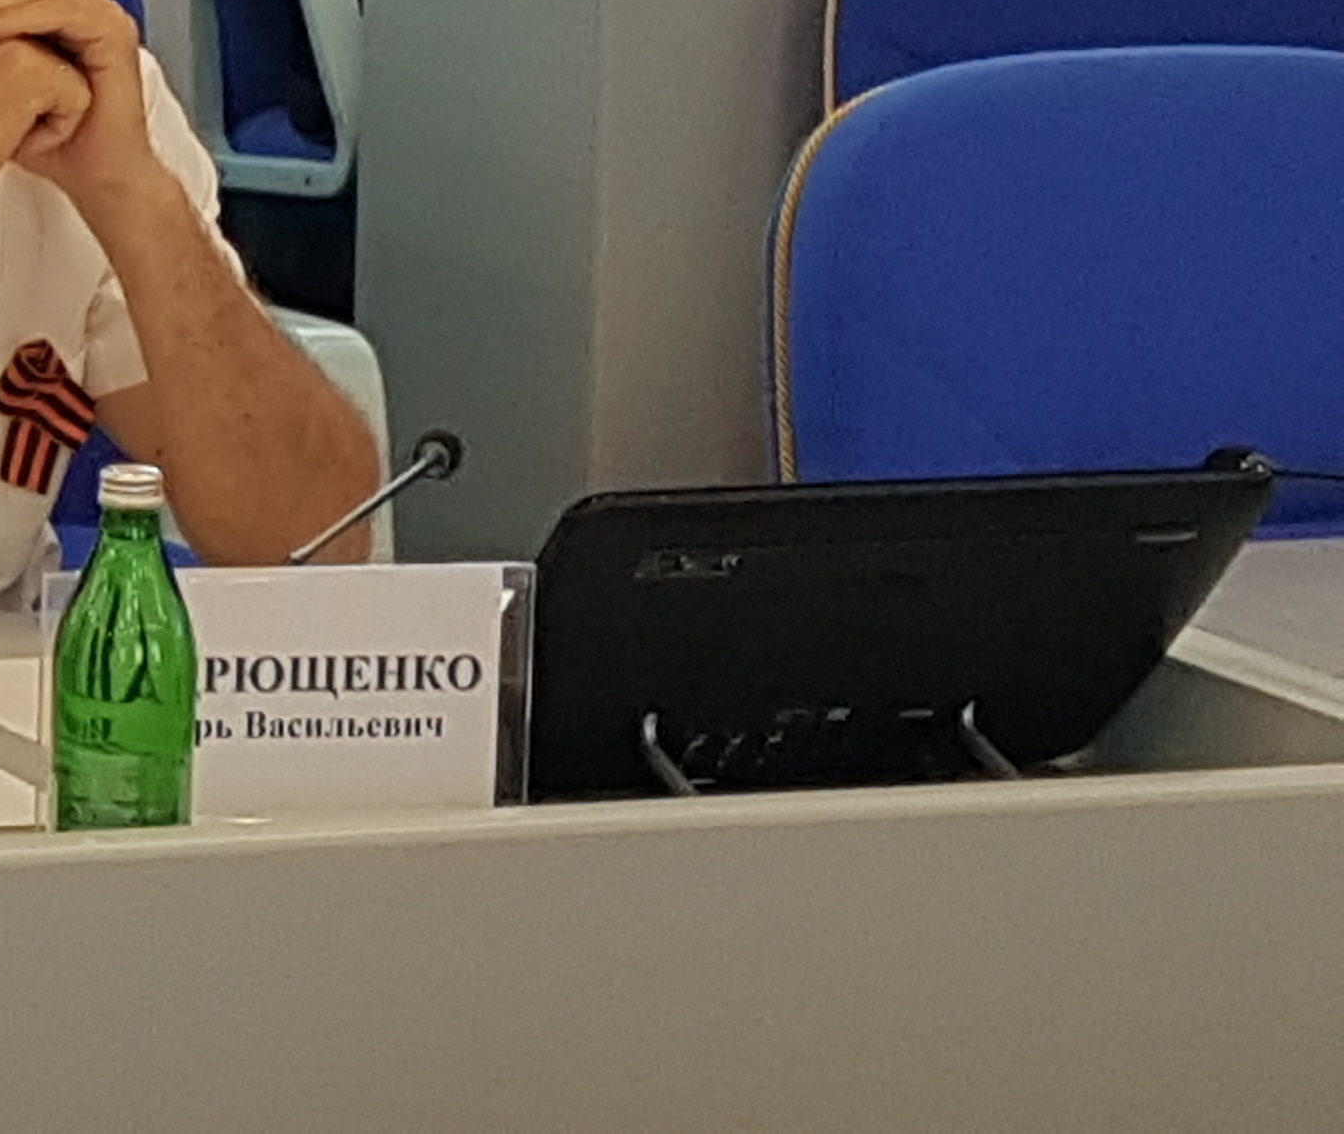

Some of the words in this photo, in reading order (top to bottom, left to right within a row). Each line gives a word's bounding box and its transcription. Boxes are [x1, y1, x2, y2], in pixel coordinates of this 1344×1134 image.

[197, 654, 483, 699] РЮЩЕНКО
[194, 718, 233, 747] рь
[245, 710, 443, 739] Васильевич
